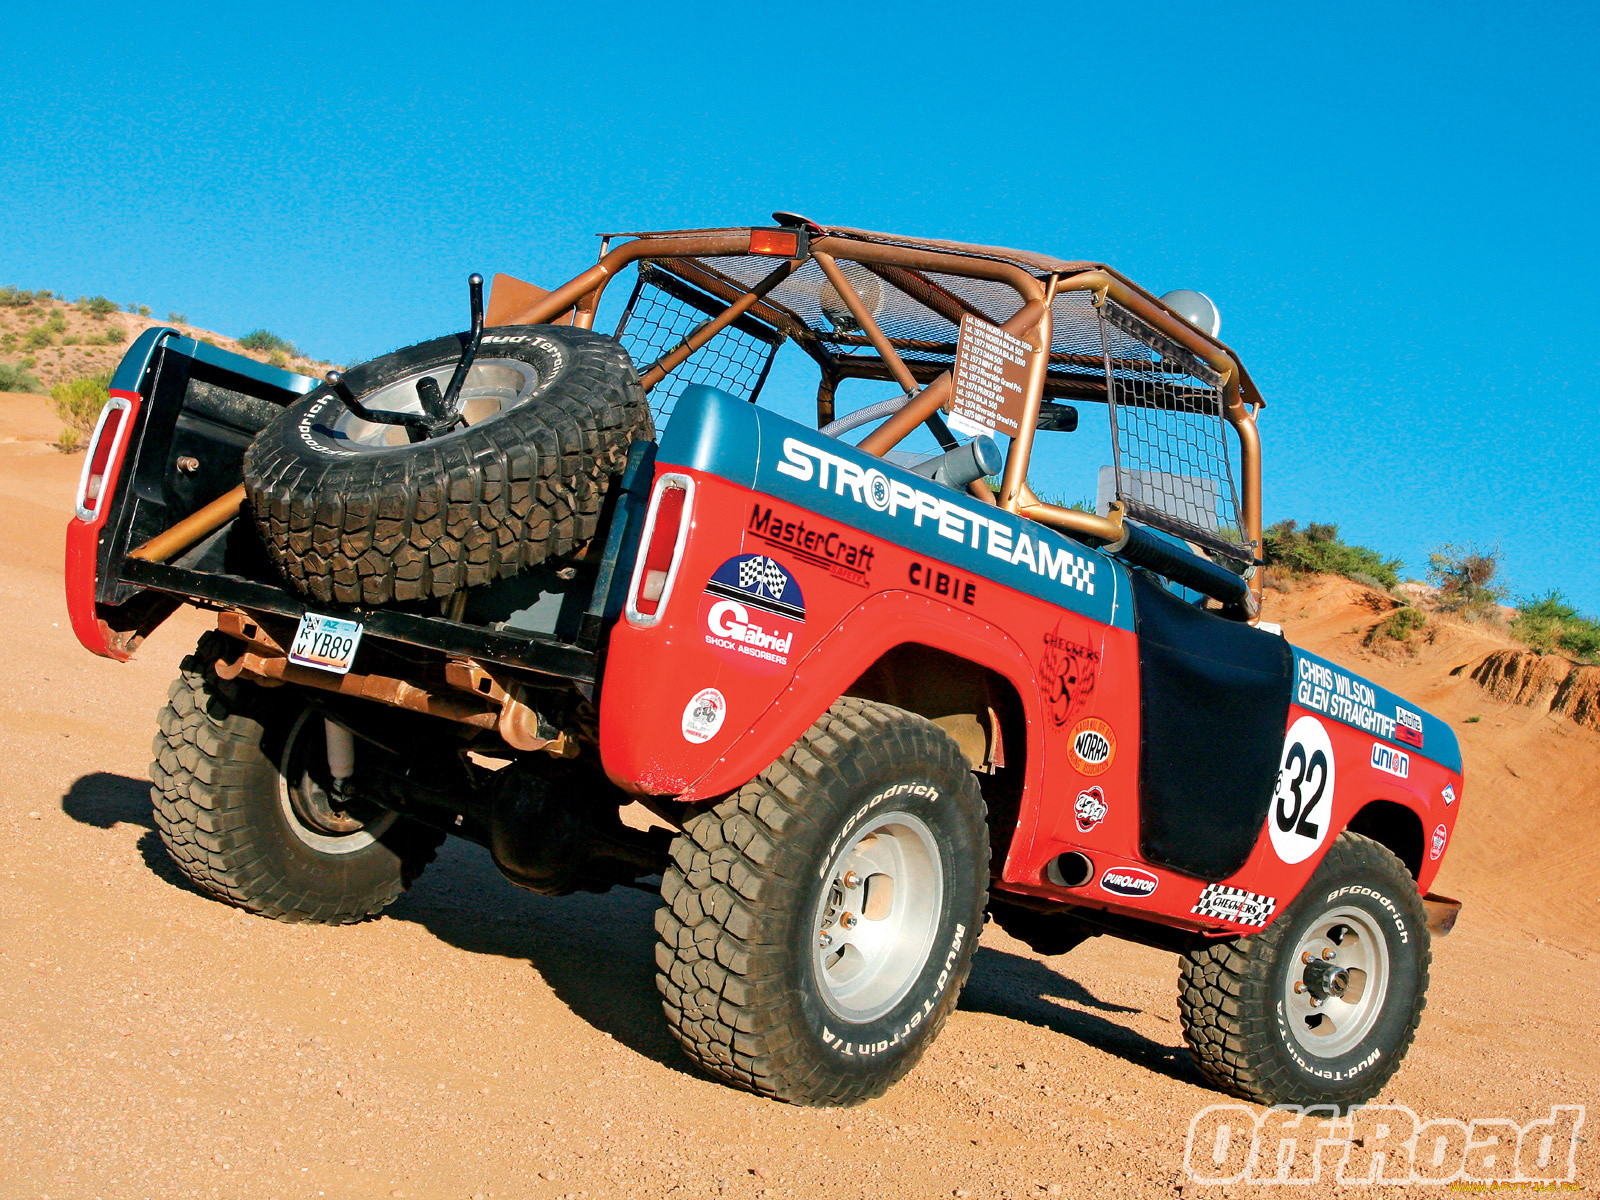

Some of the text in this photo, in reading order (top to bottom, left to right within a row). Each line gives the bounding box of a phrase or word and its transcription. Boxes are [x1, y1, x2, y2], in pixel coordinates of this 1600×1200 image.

[974, 328, 985, 338] 1970
[986, 333, 1002, 346] NORRA
[1003, 341, 1014, 352] BAJA
[1015, 346, 1024, 356] 500
[975, 319, 986, 330] 1969
[987, 324, 1003, 338] NORRA
[1004, 332, 1021, 346] Mexican
[1021, 341, 1032, 352] 1000
[970, 355, 981, 365] 1973
[982, 360, 993, 370] MINT
[993, 365, 1003, 374] 400
[971, 346, 983, 356] 1973
[994, 356, 1003, 365] 500
[986, 342, 1002, 356] NORRA
[1003, 350, 1014, 362] BAJA
[1015, 356, 1026, 367] 1000
[969, 364, 980, 374] 1973
[981, 368, 1000, 383] Riverside
[1001, 378, 1013, 389] Grand
[1013, 383, 1022, 393] Prix
[980, 378, 992, 389] BAJA
[993, 384, 1002, 392] 500
[976, 395, 987, 406] BAJA
[988, 401, 998, 410] 500
[978, 386, 995, 400] PARKER
[996, 394, 1004, 403] 400
[975, 414, 986, 424] MINT
[986, 419, 996, 428] 400
[976, 405, 996, 419] Riverside
[997, 414, 1009, 425] Grand
[1009, 419, 1018, 429] Prix
[748, 504, 875, 571] MasterCraft
[830, 565, 864, 583] SAFETY
[324, 620, 339, 630] AZ
[311, 633, 352, 661] YB89
[705, 635, 787, 665] SHOCK ABSORBERS
[1043, 632, 1100, 664] CHECKERS
[1300, 657, 1376, 709] CHRIS WILSON
[1298, 681, 1396, 739] GLEN STRAIGHTIFF
[1076, 733, 1108, 761] NORRA
[1276, 742, 1327, 840] 32
[819, 782, 939, 879] BFGoodrich
[1104, 873, 1155, 891] PUROLATOR
[1326, 885, 1408, 944] BFGoodrich
[822, 923, 966, 1056] Mud-Terrain T/A
[1286, 1042, 1381, 1081] Mud-Terrain
